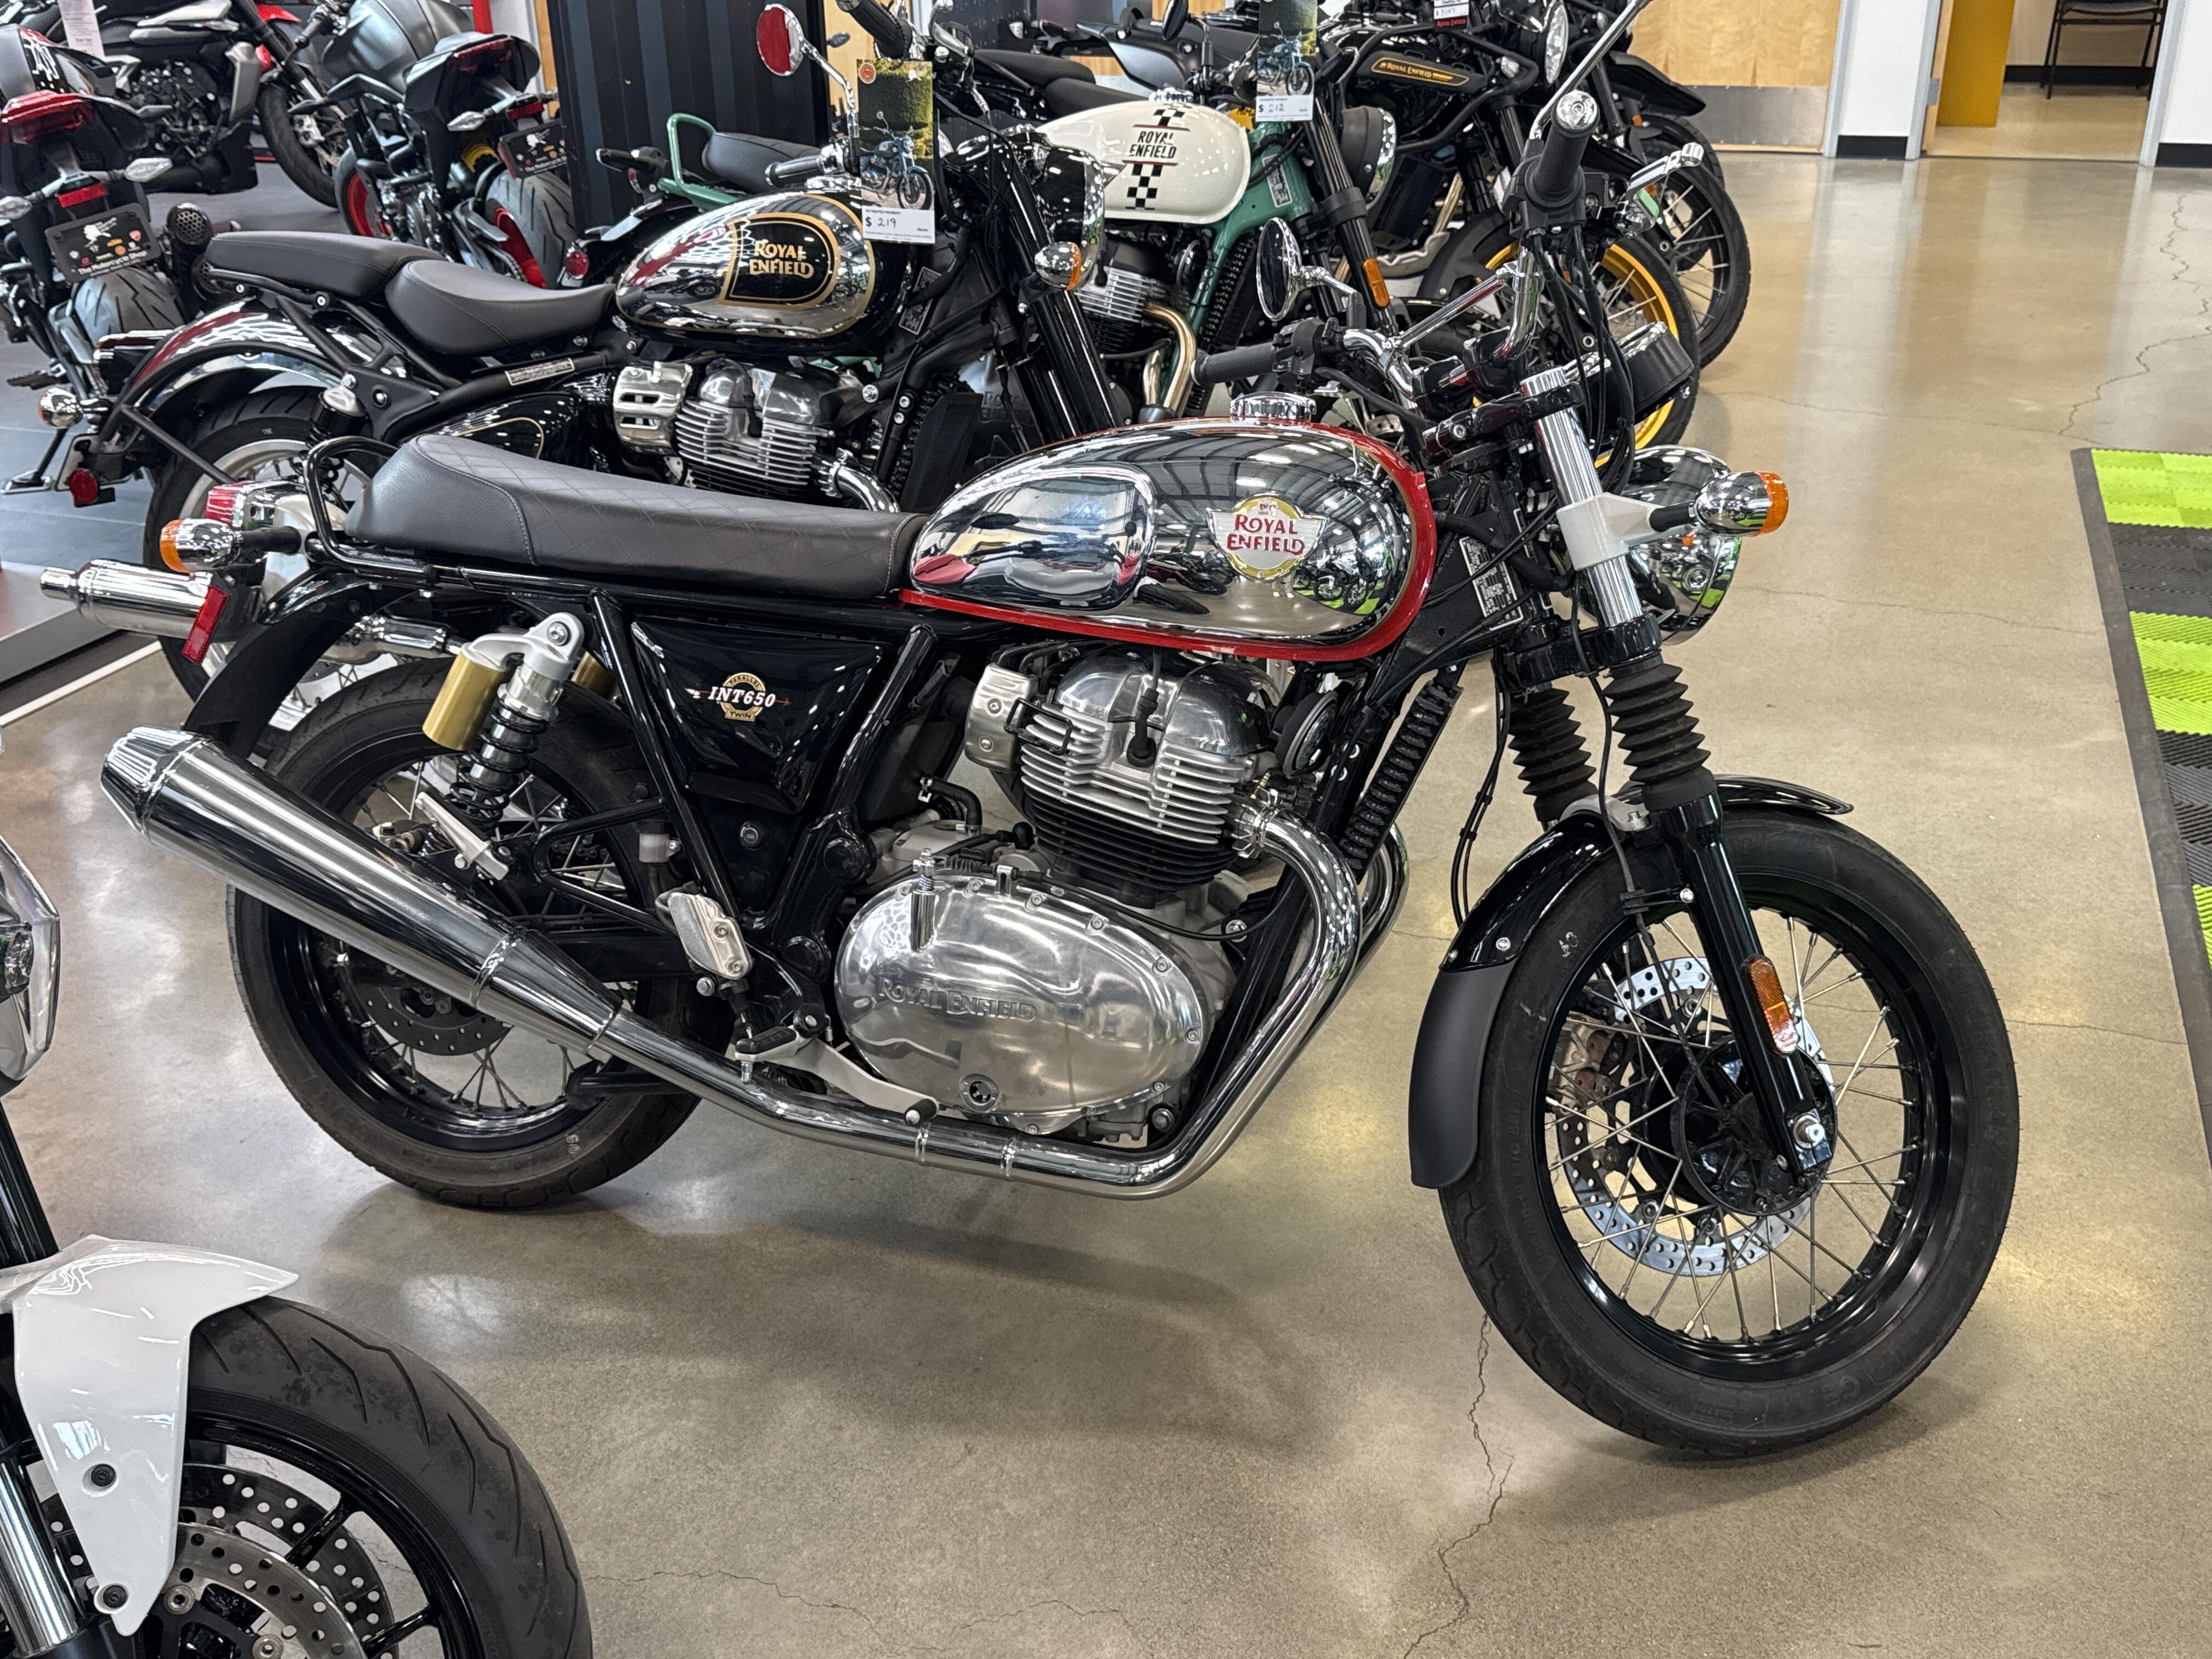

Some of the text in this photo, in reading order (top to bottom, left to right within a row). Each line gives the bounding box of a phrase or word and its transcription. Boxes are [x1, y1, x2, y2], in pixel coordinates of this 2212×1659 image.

[1386, 62, 1432, 78] ROYAL ENFIELD
[1259, 104, 1264, 113] $
[1137, 131, 1173, 145] ROYAL
[1128, 144, 1177, 159] ENFIELD
[865, 216, 896, 228] $ 219
[755, 240, 806, 261] ROYAL
[78, 267, 92, 275] The
[128, 250, 148, 260] Shop
[749, 258, 814, 279] ENFIELD
[1235, 514, 1298, 535] ROYAL
[1227, 533, 1306, 556] ENFIELD
[729, 675, 760, 688] PARALLEL
[707, 686, 776, 707] INT650
[878, 977, 1037, 1022] ROYAL ENFIELD
